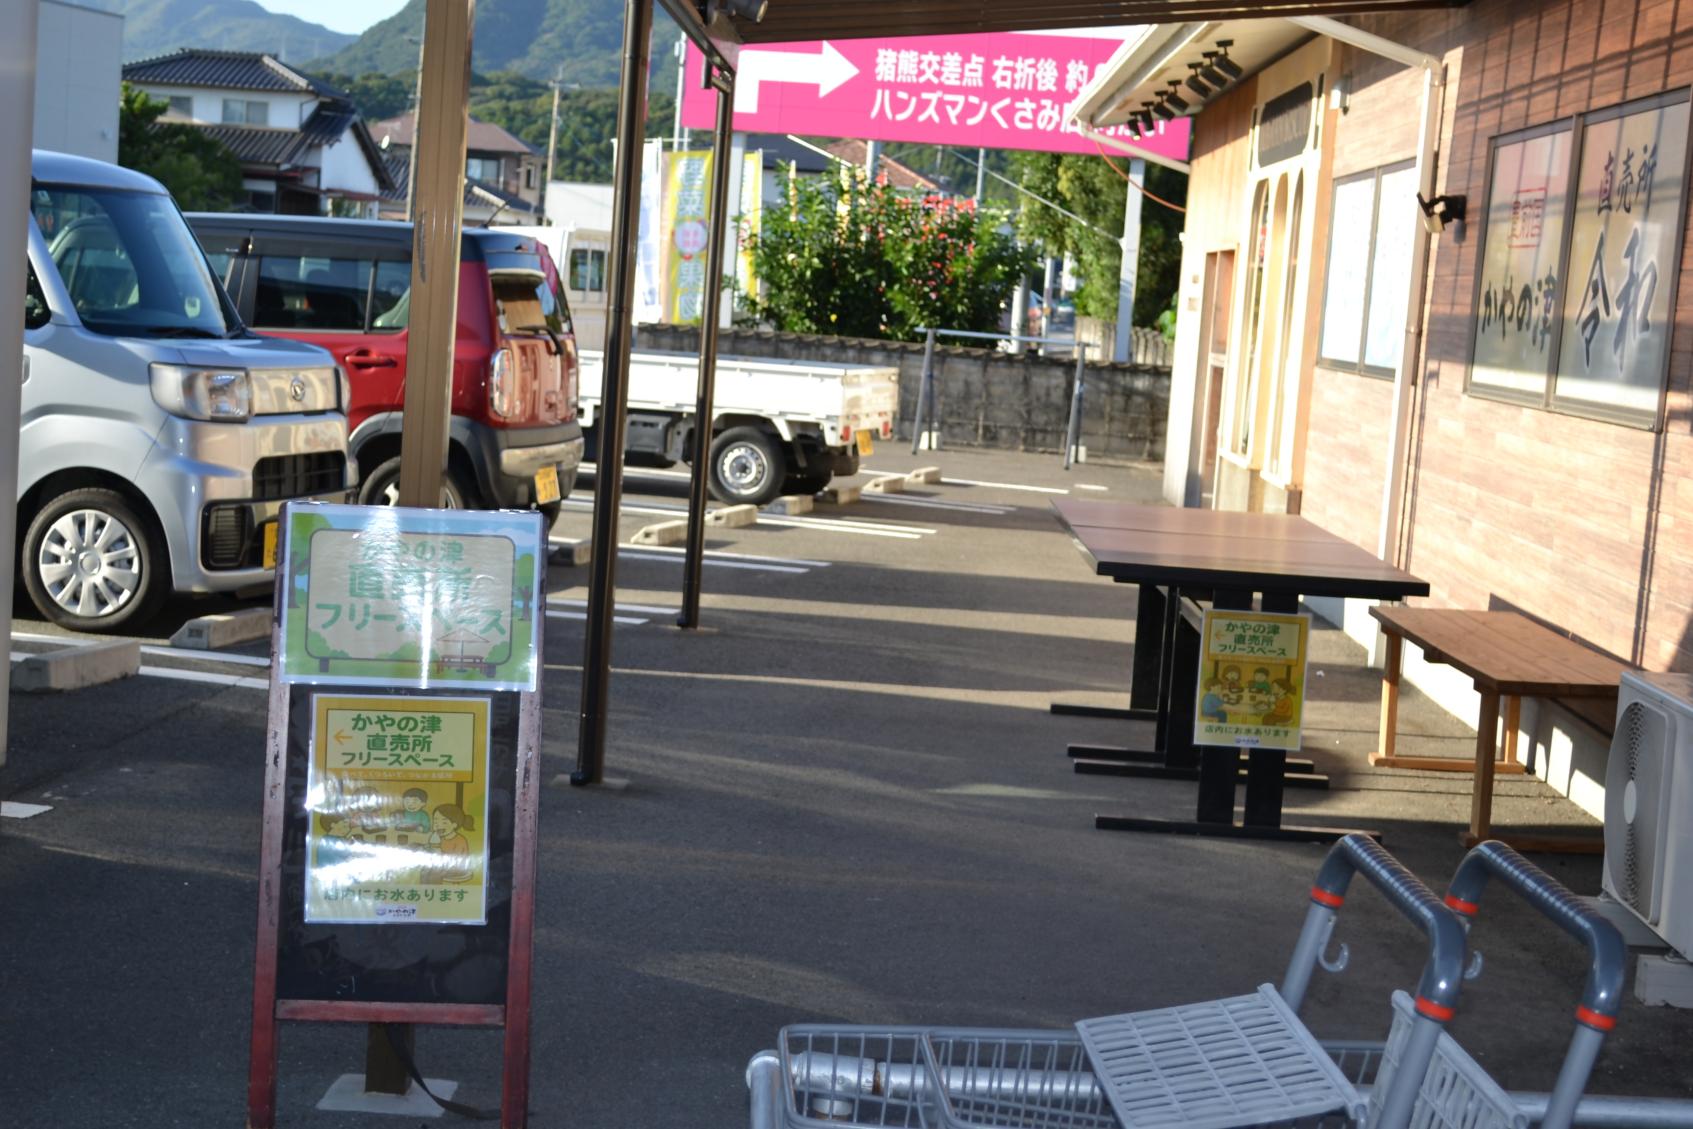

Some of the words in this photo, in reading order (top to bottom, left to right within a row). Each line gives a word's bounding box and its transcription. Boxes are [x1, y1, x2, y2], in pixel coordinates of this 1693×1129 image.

[875, 48, 983, 88] 猪熊交差点
[991, 57, 1058, 93] 右折後
[1597, 142, 1656, 216] 直売所
[1481, 265, 1557, 353] かやの津
[1575, 226, 1658, 371] 令和
[1225, 622, 1280, 635] かやの津
[1234, 634, 1274, 647] 直売所
[351, 713, 443, 734] かやの津
[366, 734, 433, 752] 直売所
[341, 751, 455, 768] フリースペース
